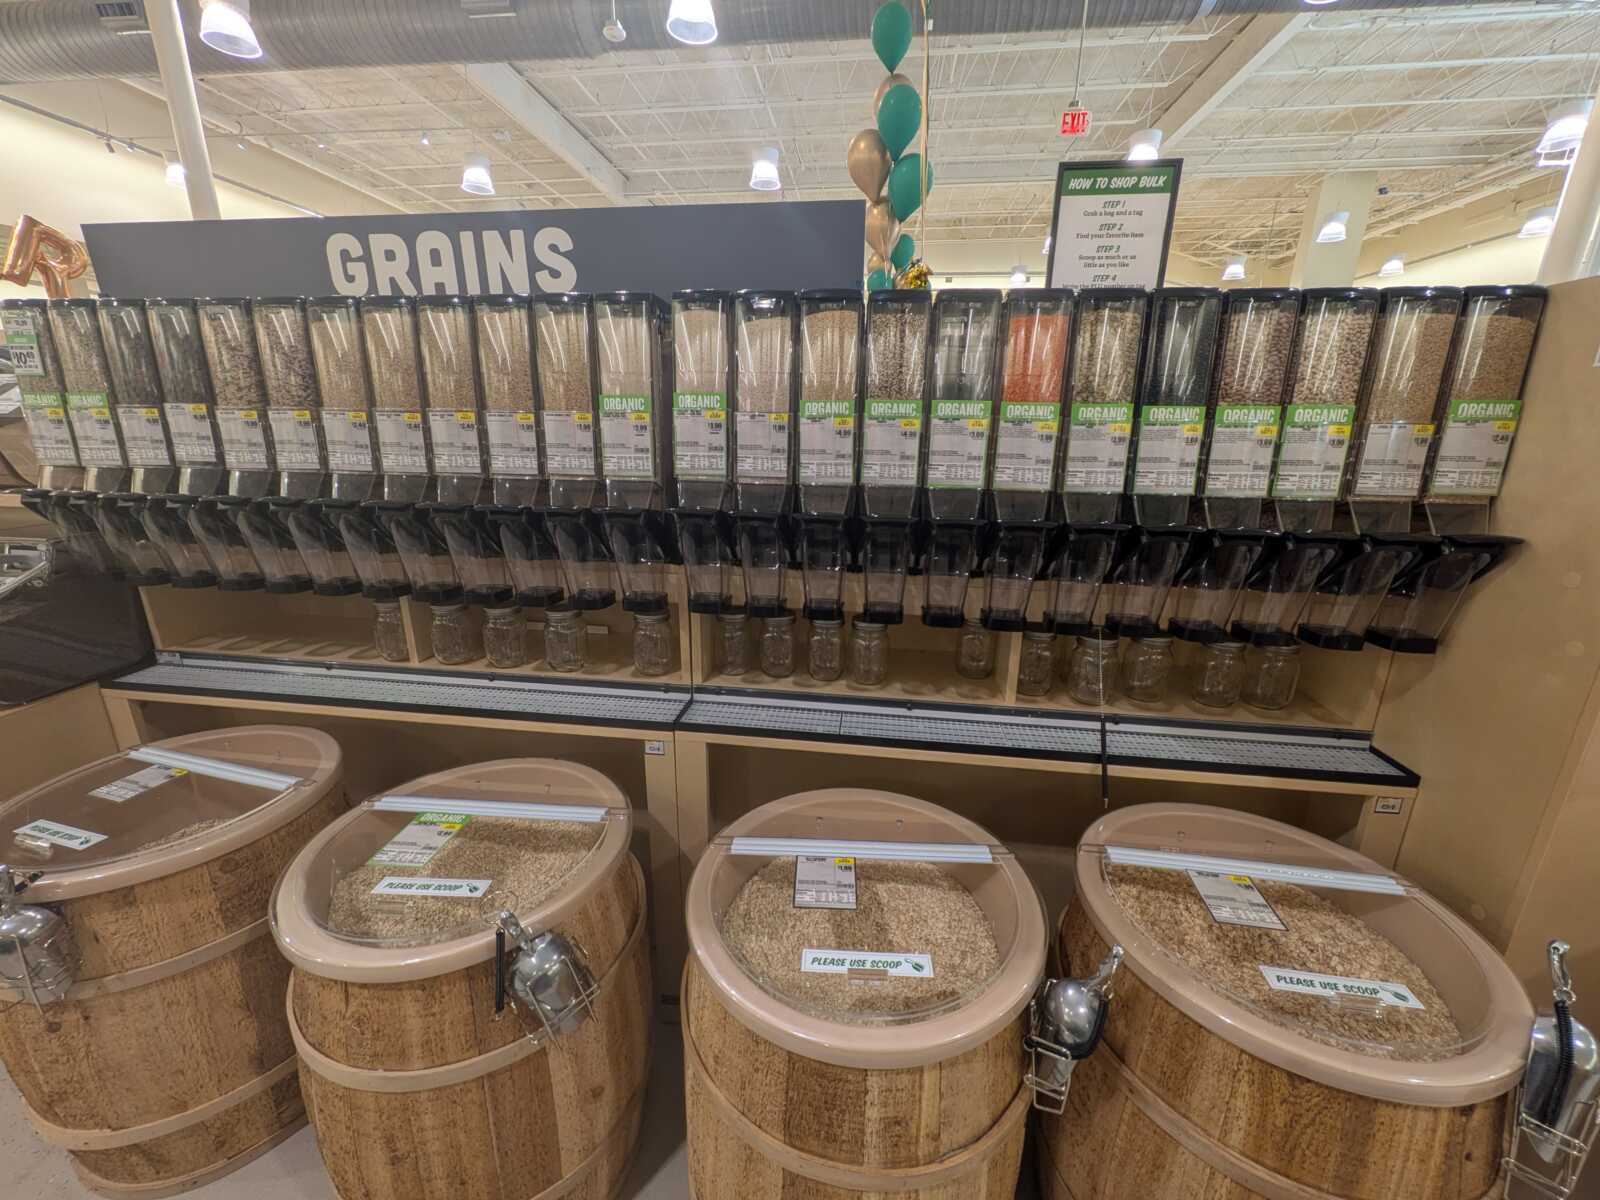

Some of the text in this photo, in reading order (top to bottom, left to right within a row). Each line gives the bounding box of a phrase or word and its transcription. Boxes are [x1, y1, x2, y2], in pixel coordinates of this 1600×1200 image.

[1061, 112, 1088, 133] EXIT
[1068, 175, 1168, 190] HOW TO SHOP BULK
[1102, 200, 1121, 209] STEP
[1083, 209, 1098, 217] Grab
[1103, 209, 1114, 218] bag
[1132, 209, 1143, 218] tag
[1098, 223, 1124, 231] STEP 2
[1090, 233, 1104, 241] your
[1096, 245, 1121, 253] STEP 3
[326, 226, 577, 296] GRAINS
[1092, 274, 1118, 282] STEP 4
[604, 397, 645, 410] ORGANIC
[678, 395, 721, 408] ORGANIC
[805, 402, 849, 415] ORGANIC
[871, 403, 917, 416] ORGANIC
[938, 402, 985, 416] ORGANIC
[1006, 404, 1055, 418] ORGANIC
[1079, 406, 1128, 420] ORGANIC
[1150, 407, 1199, 421] ORGANIC
[1457, 403, 1515, 418] ORGANIC
[1223, 408, 1275, 423] ORGANIC
[1295, 408, 1349, 423] ORGANIC
[419, 813, 466, 823] ORGANIC
[383, 881, 416, 890] PLEASE
[432, 883, 463, 891] SCOOP
[811, 956, 903, 969] PLEASE USE SCOOP
[1275, 974, 1380, 996] PLEASE USE SCOOP
